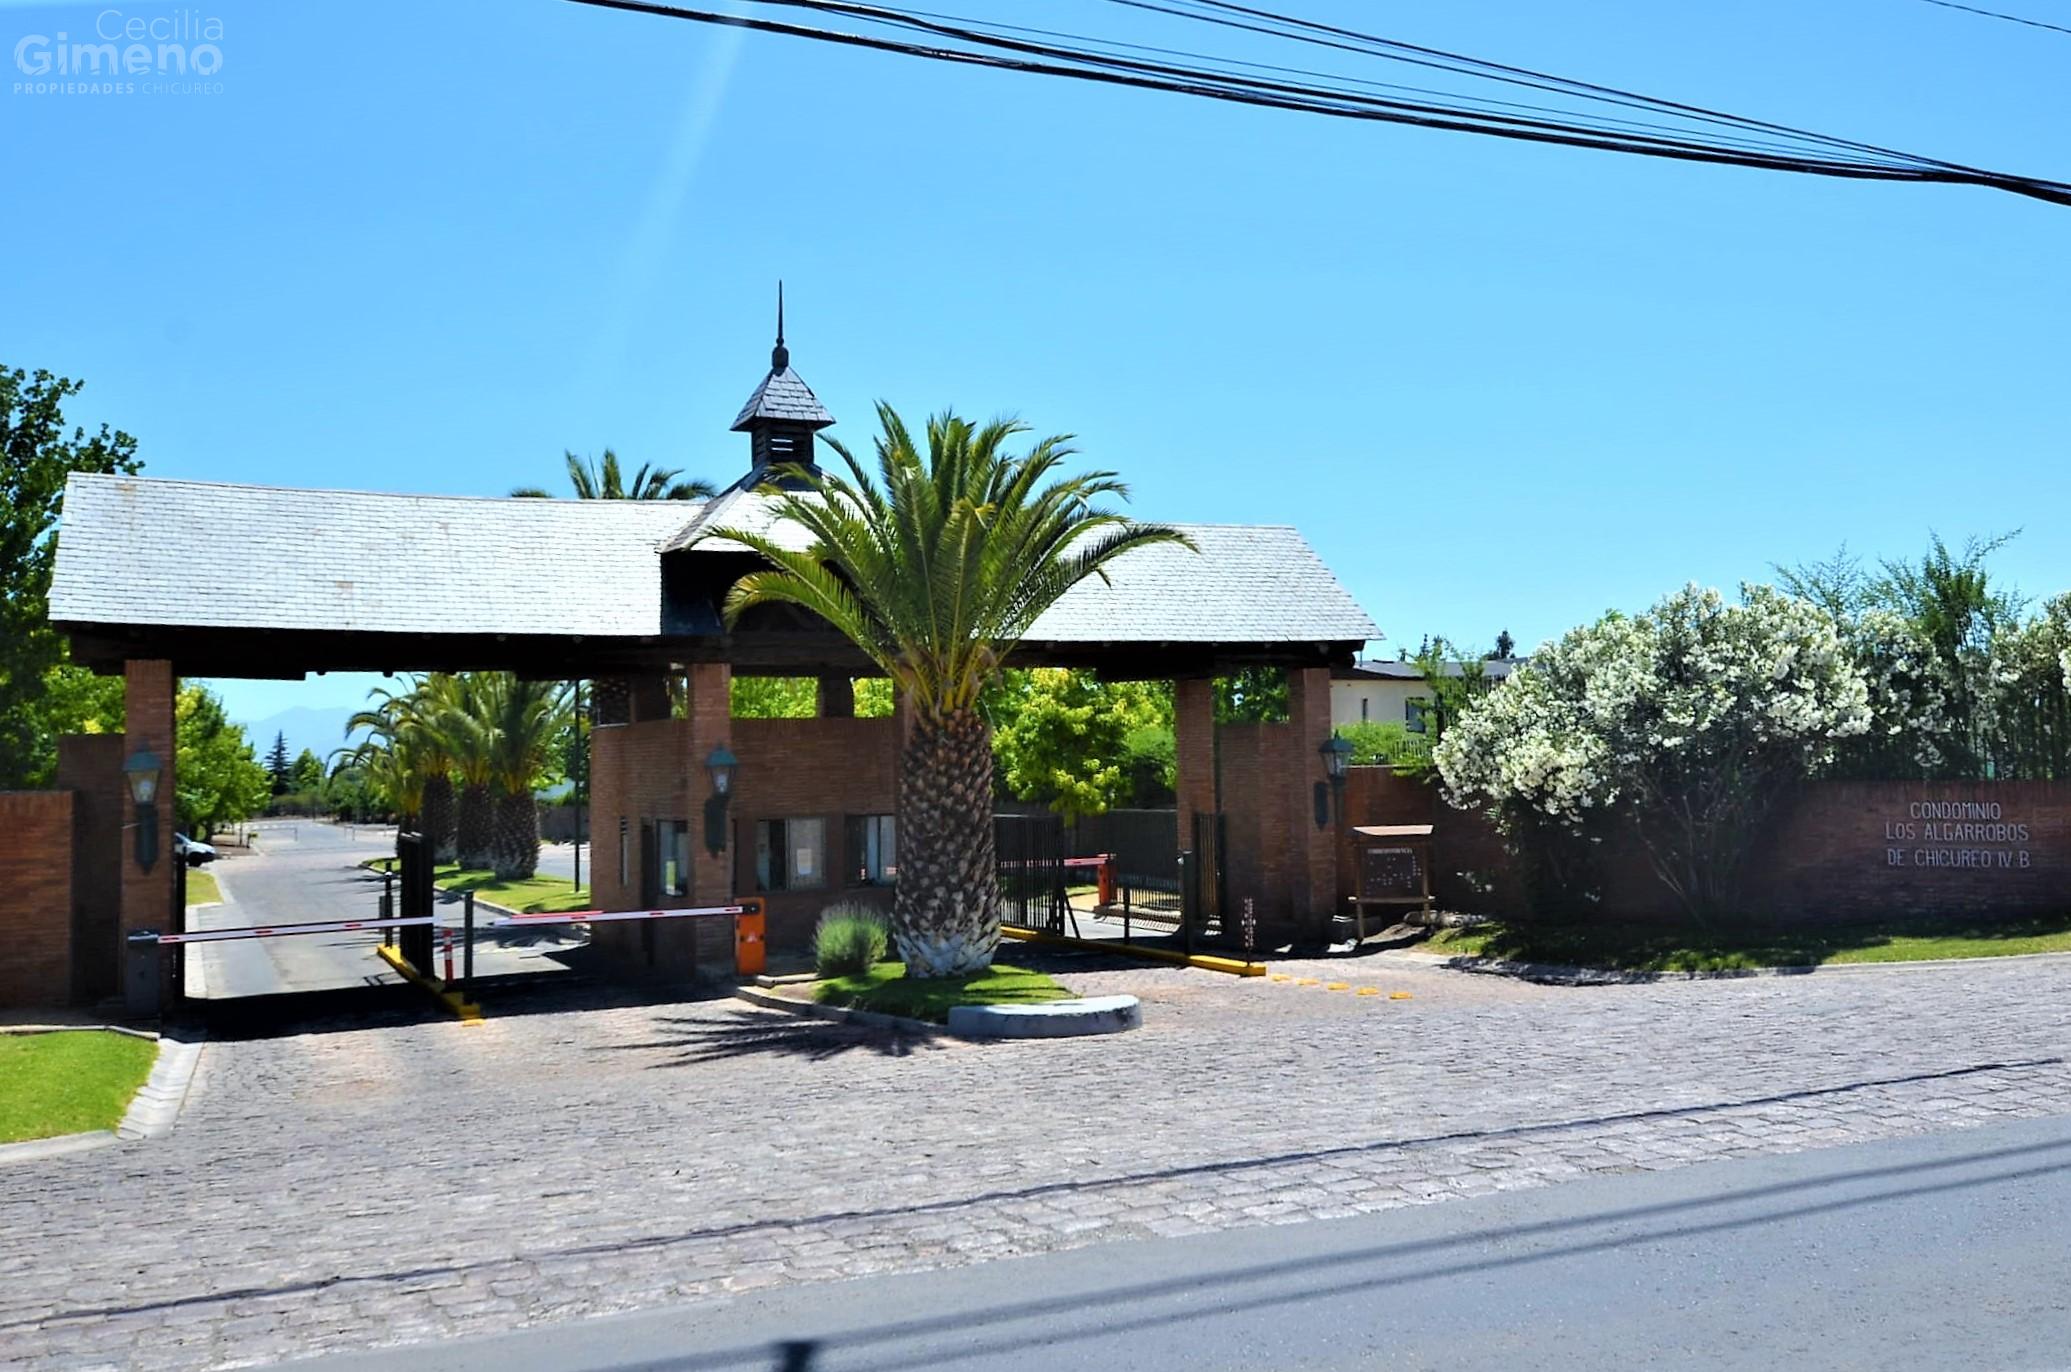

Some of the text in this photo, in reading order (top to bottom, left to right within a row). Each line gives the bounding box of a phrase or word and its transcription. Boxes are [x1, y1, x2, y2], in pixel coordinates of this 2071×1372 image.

[1910, 802, 2001, 820] CONDOMINIO
[1886, 822, 2029, 841] LOS ALGARROBOS
[1887, 848, 1905, 866] DE
[1914, 849, 1992, 868] CHICUREO
[2019, 850, 2031, 868] B
